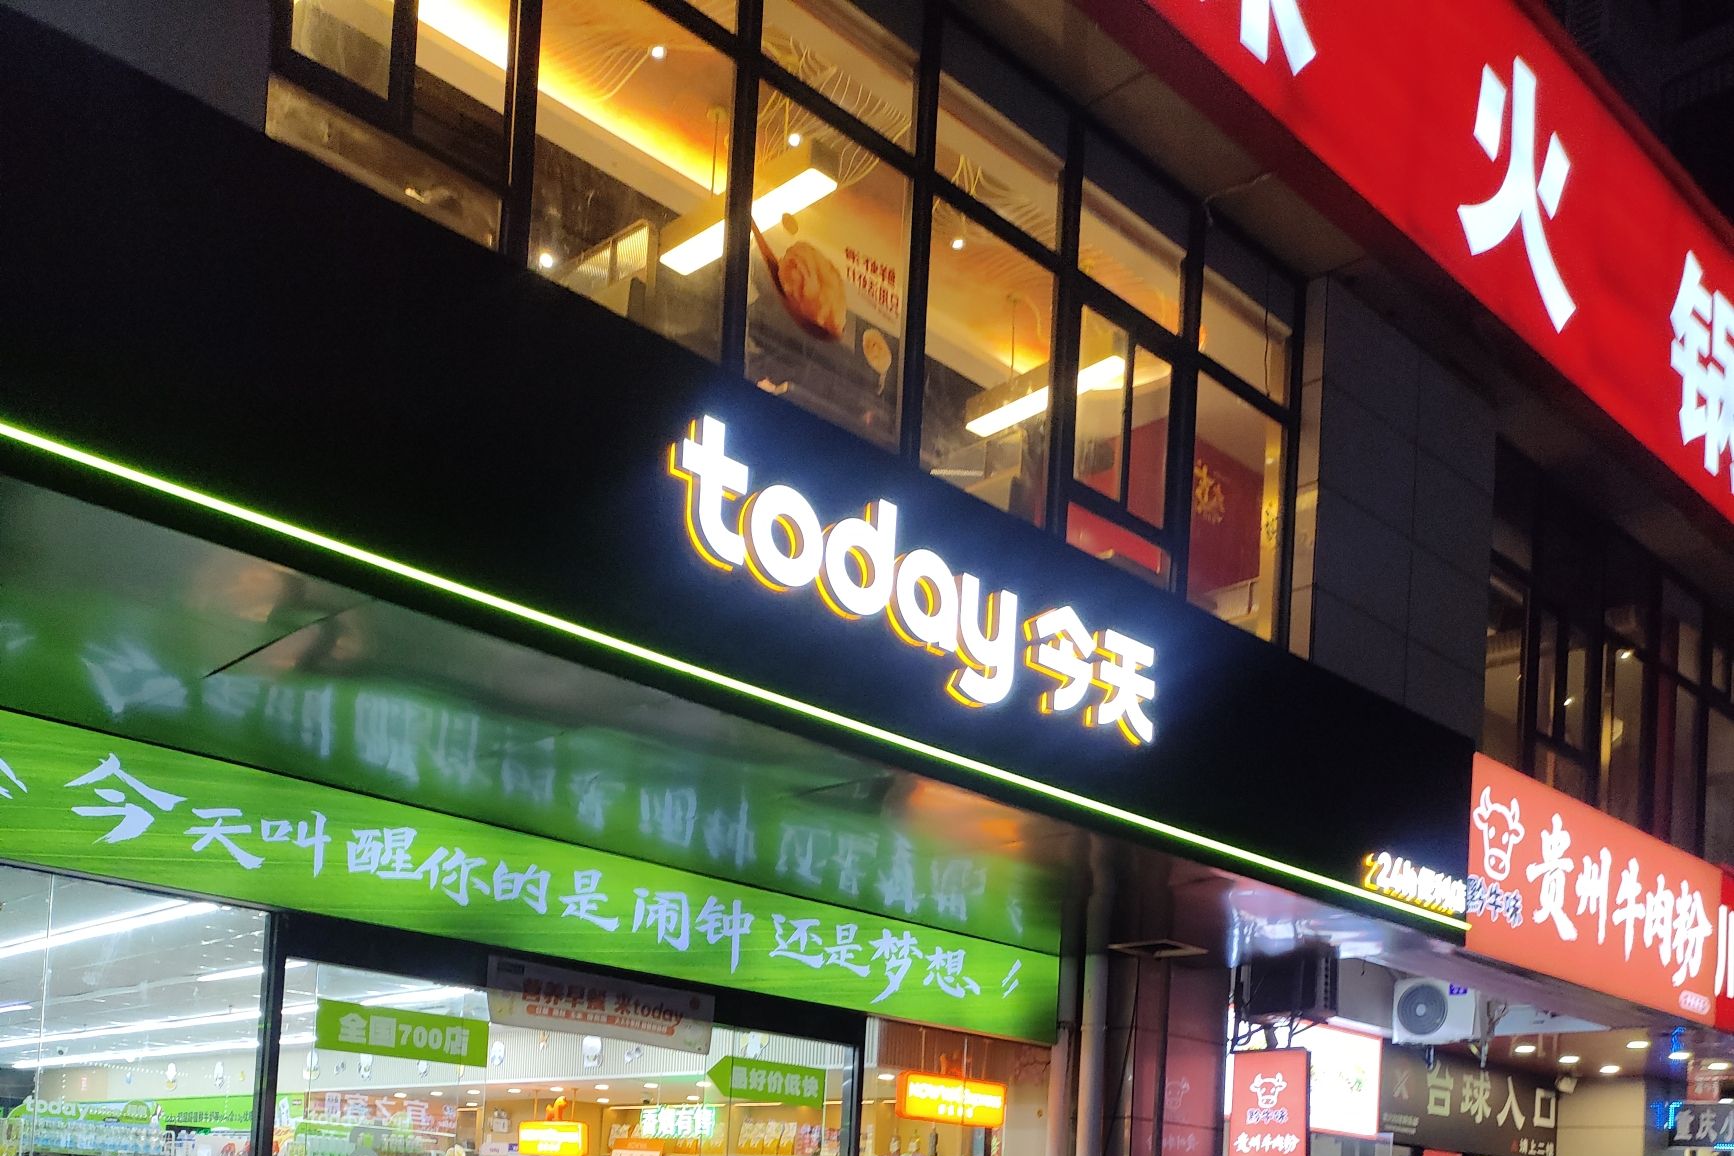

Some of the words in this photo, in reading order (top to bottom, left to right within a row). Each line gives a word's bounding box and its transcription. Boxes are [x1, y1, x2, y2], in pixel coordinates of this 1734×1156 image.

[670, 414, 1018, 706] today
[1025, 604, 1156, 745] 今天
[64, 752, 982, 1004] 今天叫醒你的是闹钟还是梦想
[1526, 813, 1713, 987] 贵州牛肉粉
[338, 1012, 470, 1057] 全国700店
[1426, 1059, 1557, 1132] 台球入口
